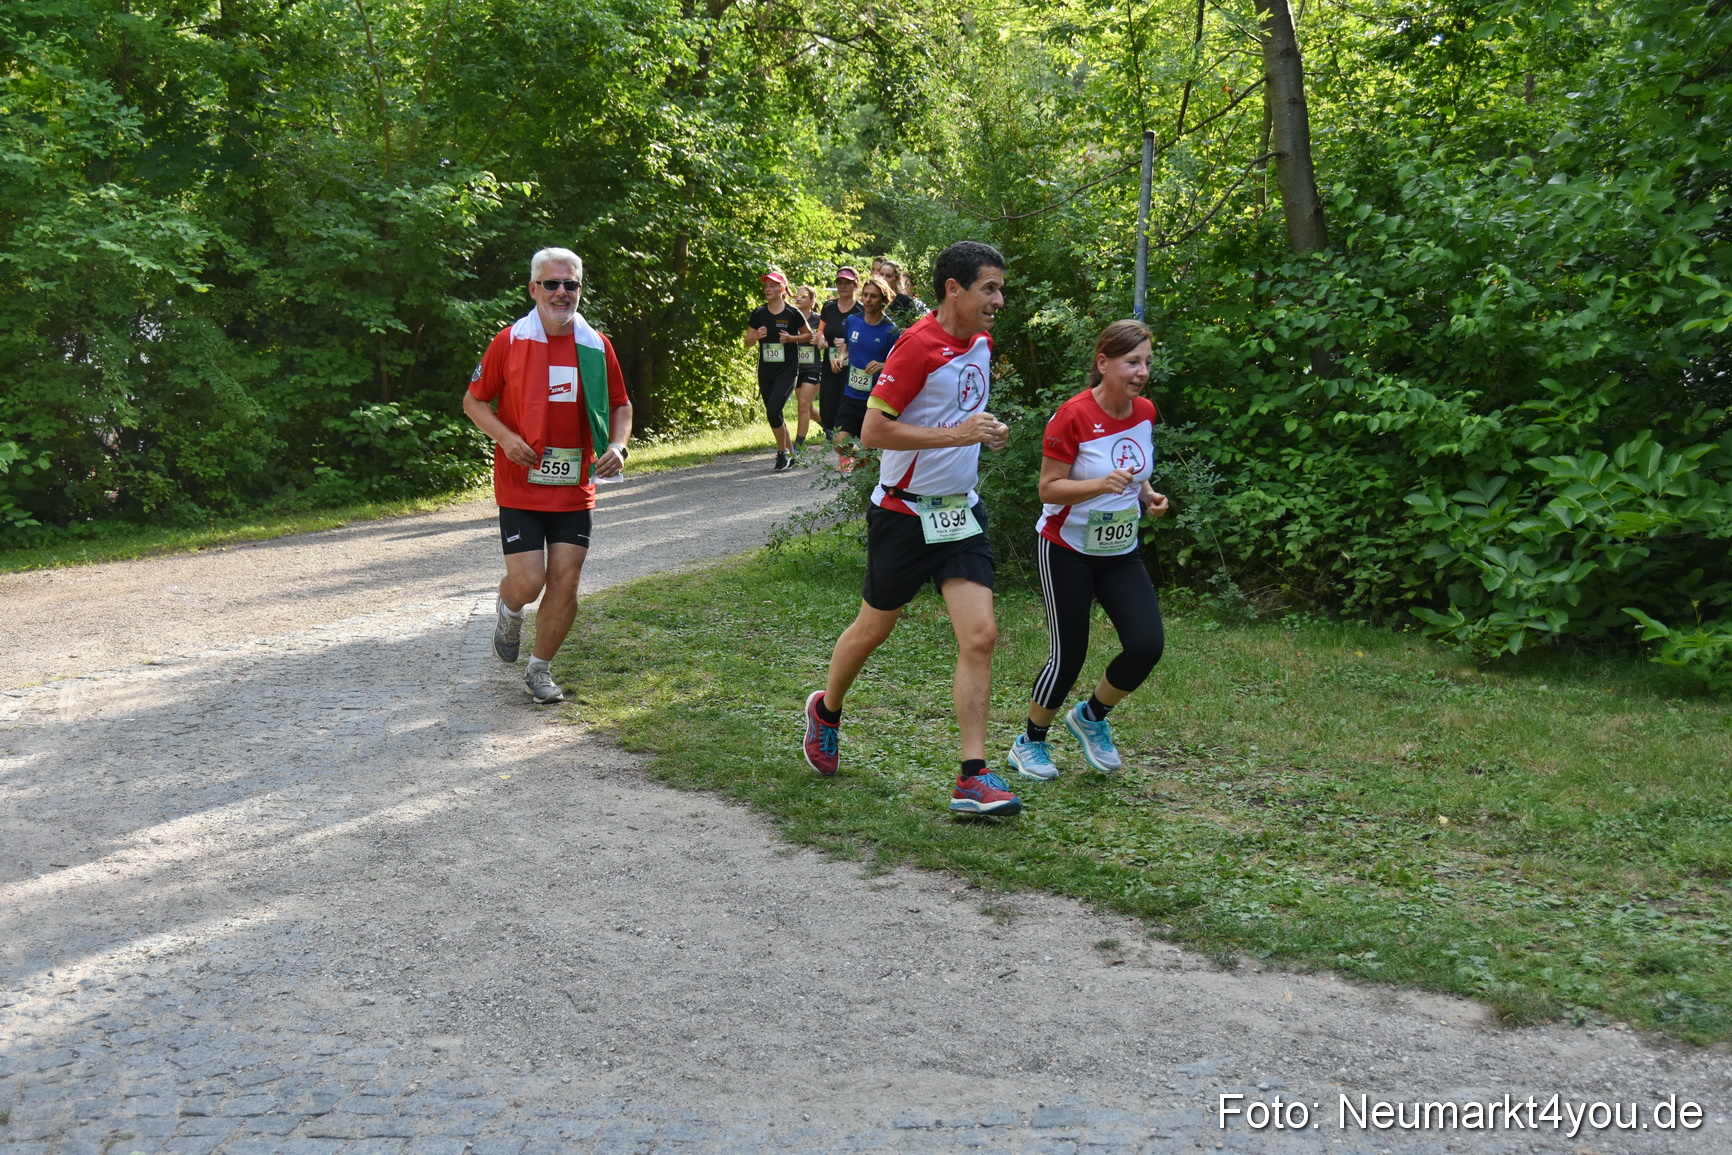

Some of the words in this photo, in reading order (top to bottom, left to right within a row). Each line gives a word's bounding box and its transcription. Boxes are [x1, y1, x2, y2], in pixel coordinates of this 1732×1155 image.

[766, 349, 779, 357] 130
[850, 373, 869, 386] 2022
[541, 460, 570, 475] 559
[929, 509, 967, 529] 1899
[1094, 522, 1133, 541] 1903
